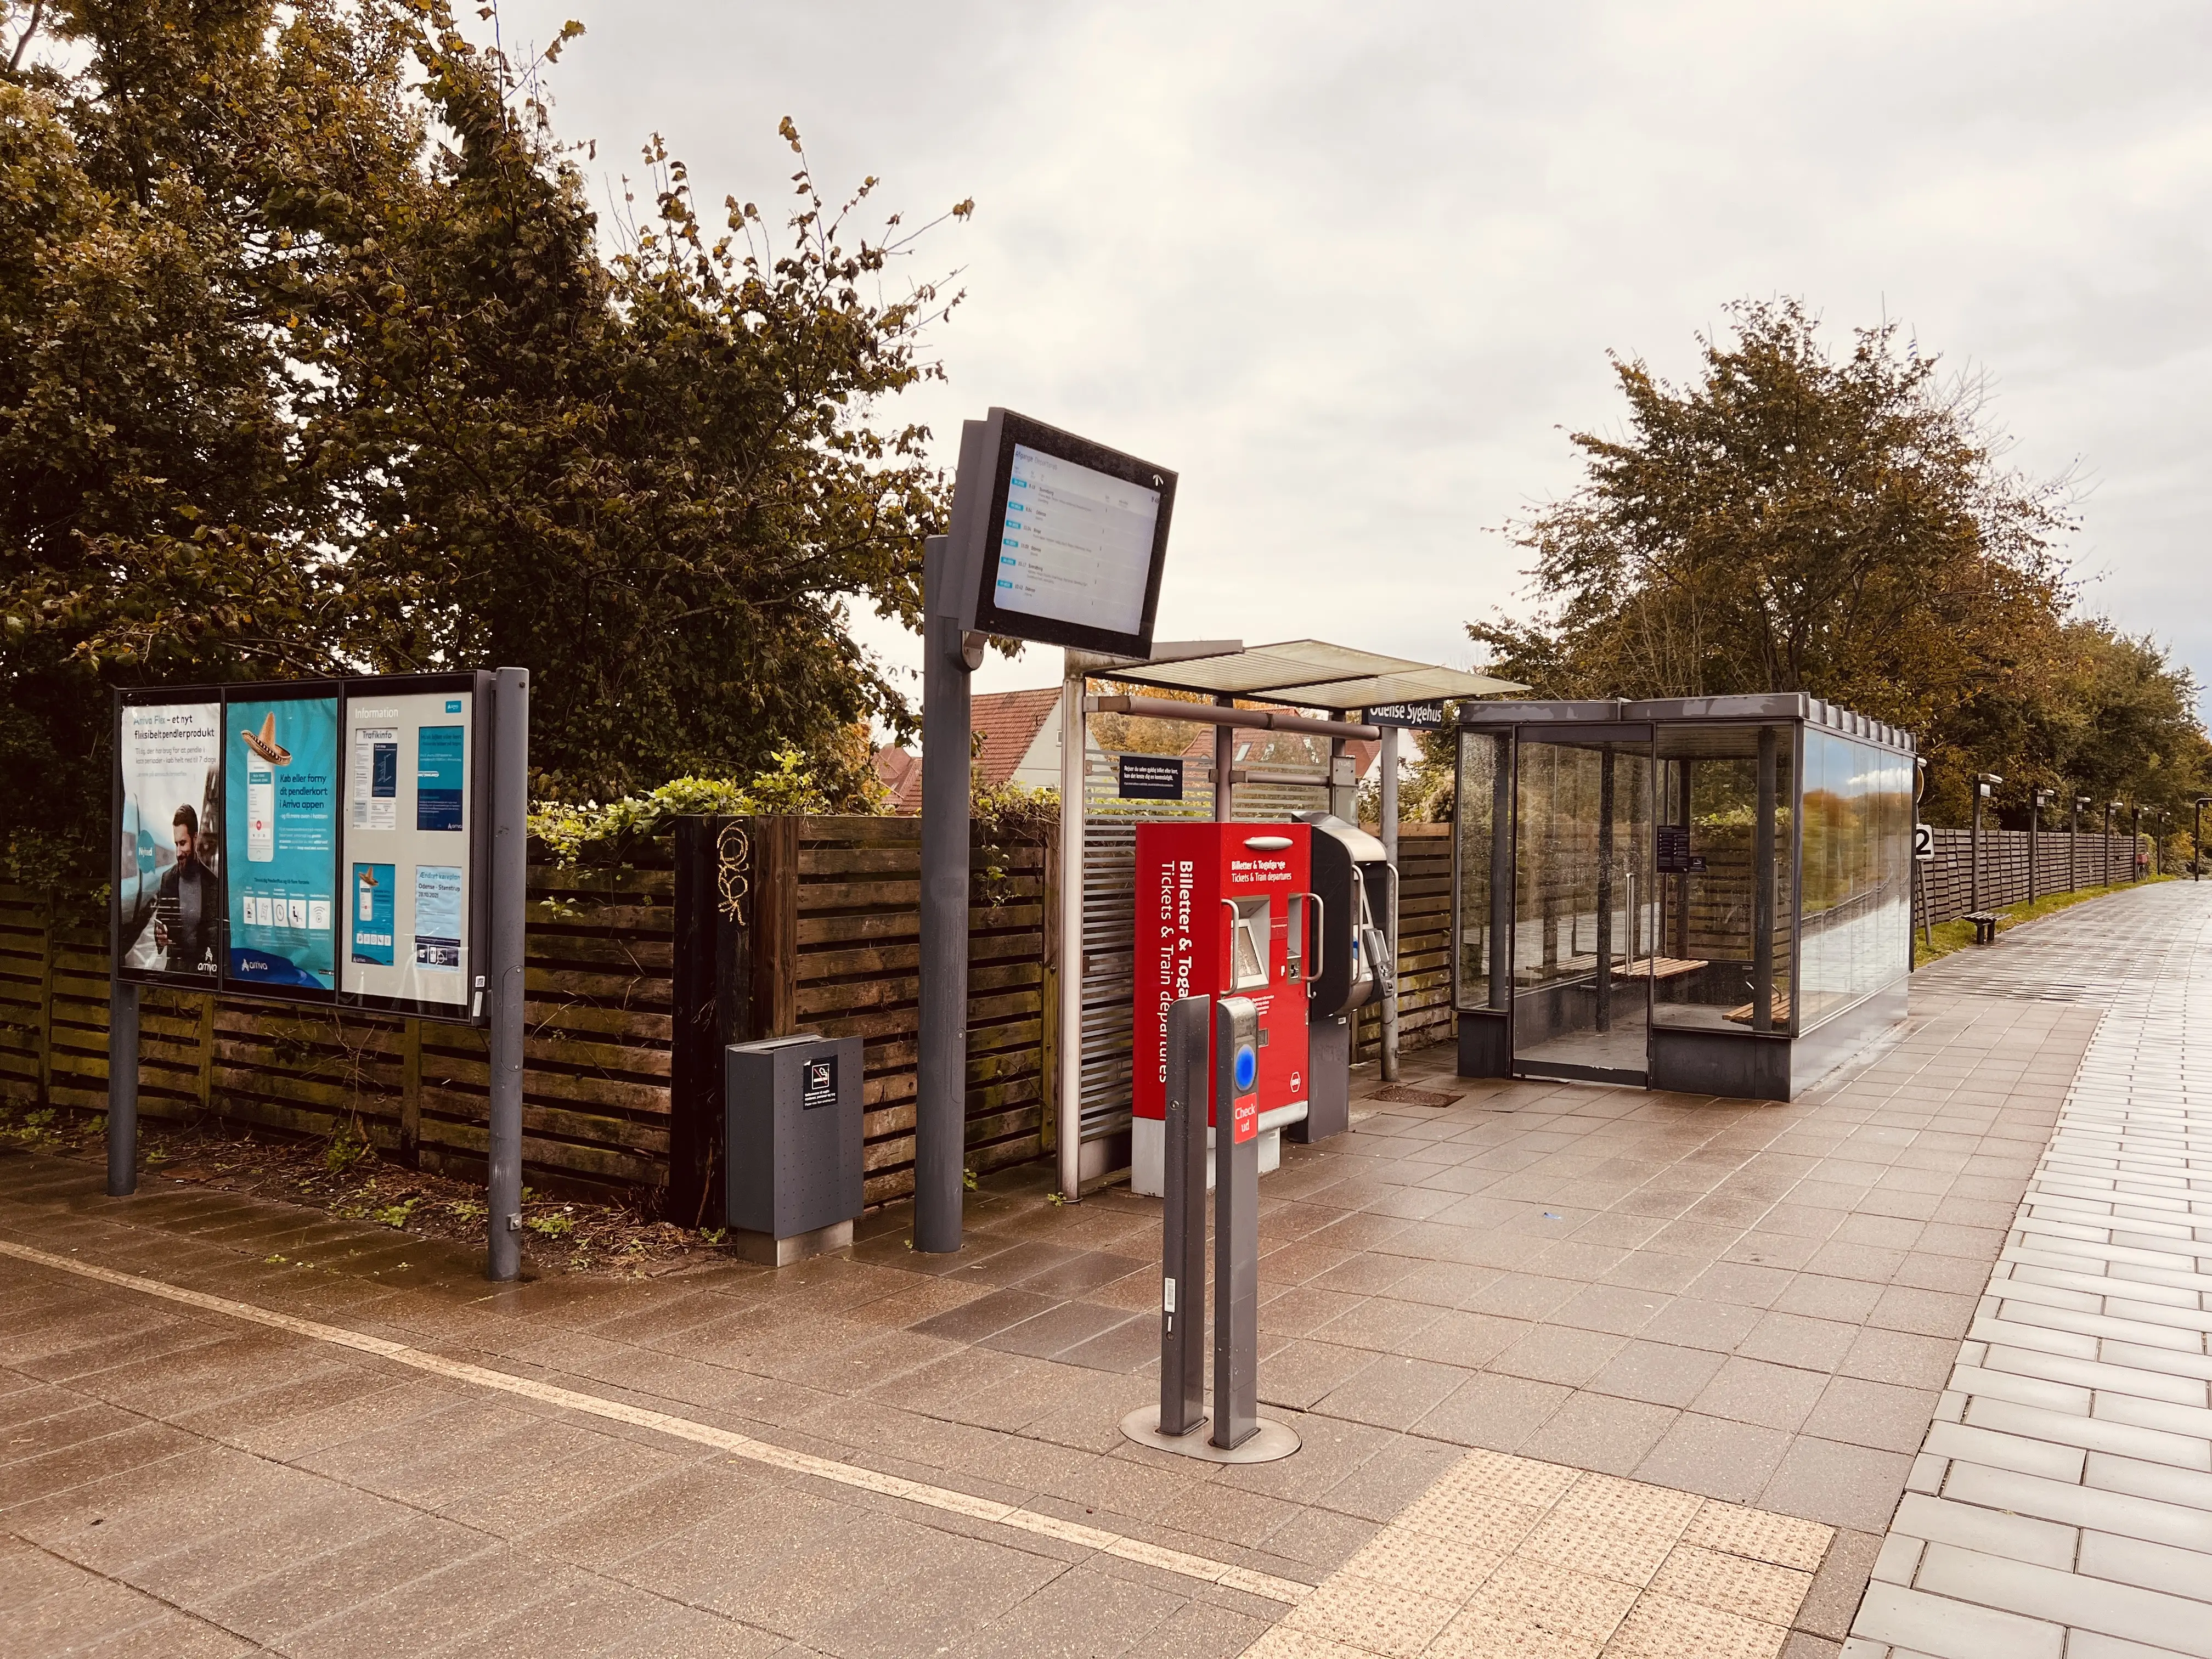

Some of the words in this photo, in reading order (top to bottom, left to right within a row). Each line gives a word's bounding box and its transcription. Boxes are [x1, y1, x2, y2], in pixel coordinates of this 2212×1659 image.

[355, 707, 398, 719] Information
[1407, 703, 1442, 724] Sygehus
[134, 715, 152, 725] Arriva
[181, 715, 193, 725] nyt
[135, 729, 162, 739] fleksibelt
[162, 728, 215, 740] pendlerprodukt
[363, 731, 392, 739] Trafikinfo
[280, 774, 291, 782] Køb
[292, 774, 306, 782] eller
[308, 774, 327, 785] forny
[289, 787, 328, 797] pendlerkort
[283, 799, 300, 808] Arriva
[302, 802, 324, 811] appen
[1916, 829, 1931, 855] 2
[1232, 861, 1252, 870] Billetter
[1253, 860, 1257, 870] &
[1232, 873, 1249, 883] Tickets
[1250, 872, 1254, 882] &
[1255, 872, 1267, 882] Train
[1267, 872, 1291, 883] departures
[1161, 861, 1175, 920] Tickets
[1180, 861, 1193, 933] Billetter
[1161, 926, 1174, 938] &
[1179, 938, 1192, 951] &
[198, 961, 217, 972] arriva
[249, 961, 267, 970] arriva
[1161, 944, 1173, 985] Train
[1157, 991, 1173, 1083] departures
[1235, 1103, 1255, 1119] Check
[1241, 1119, 1250, 1133] ud
